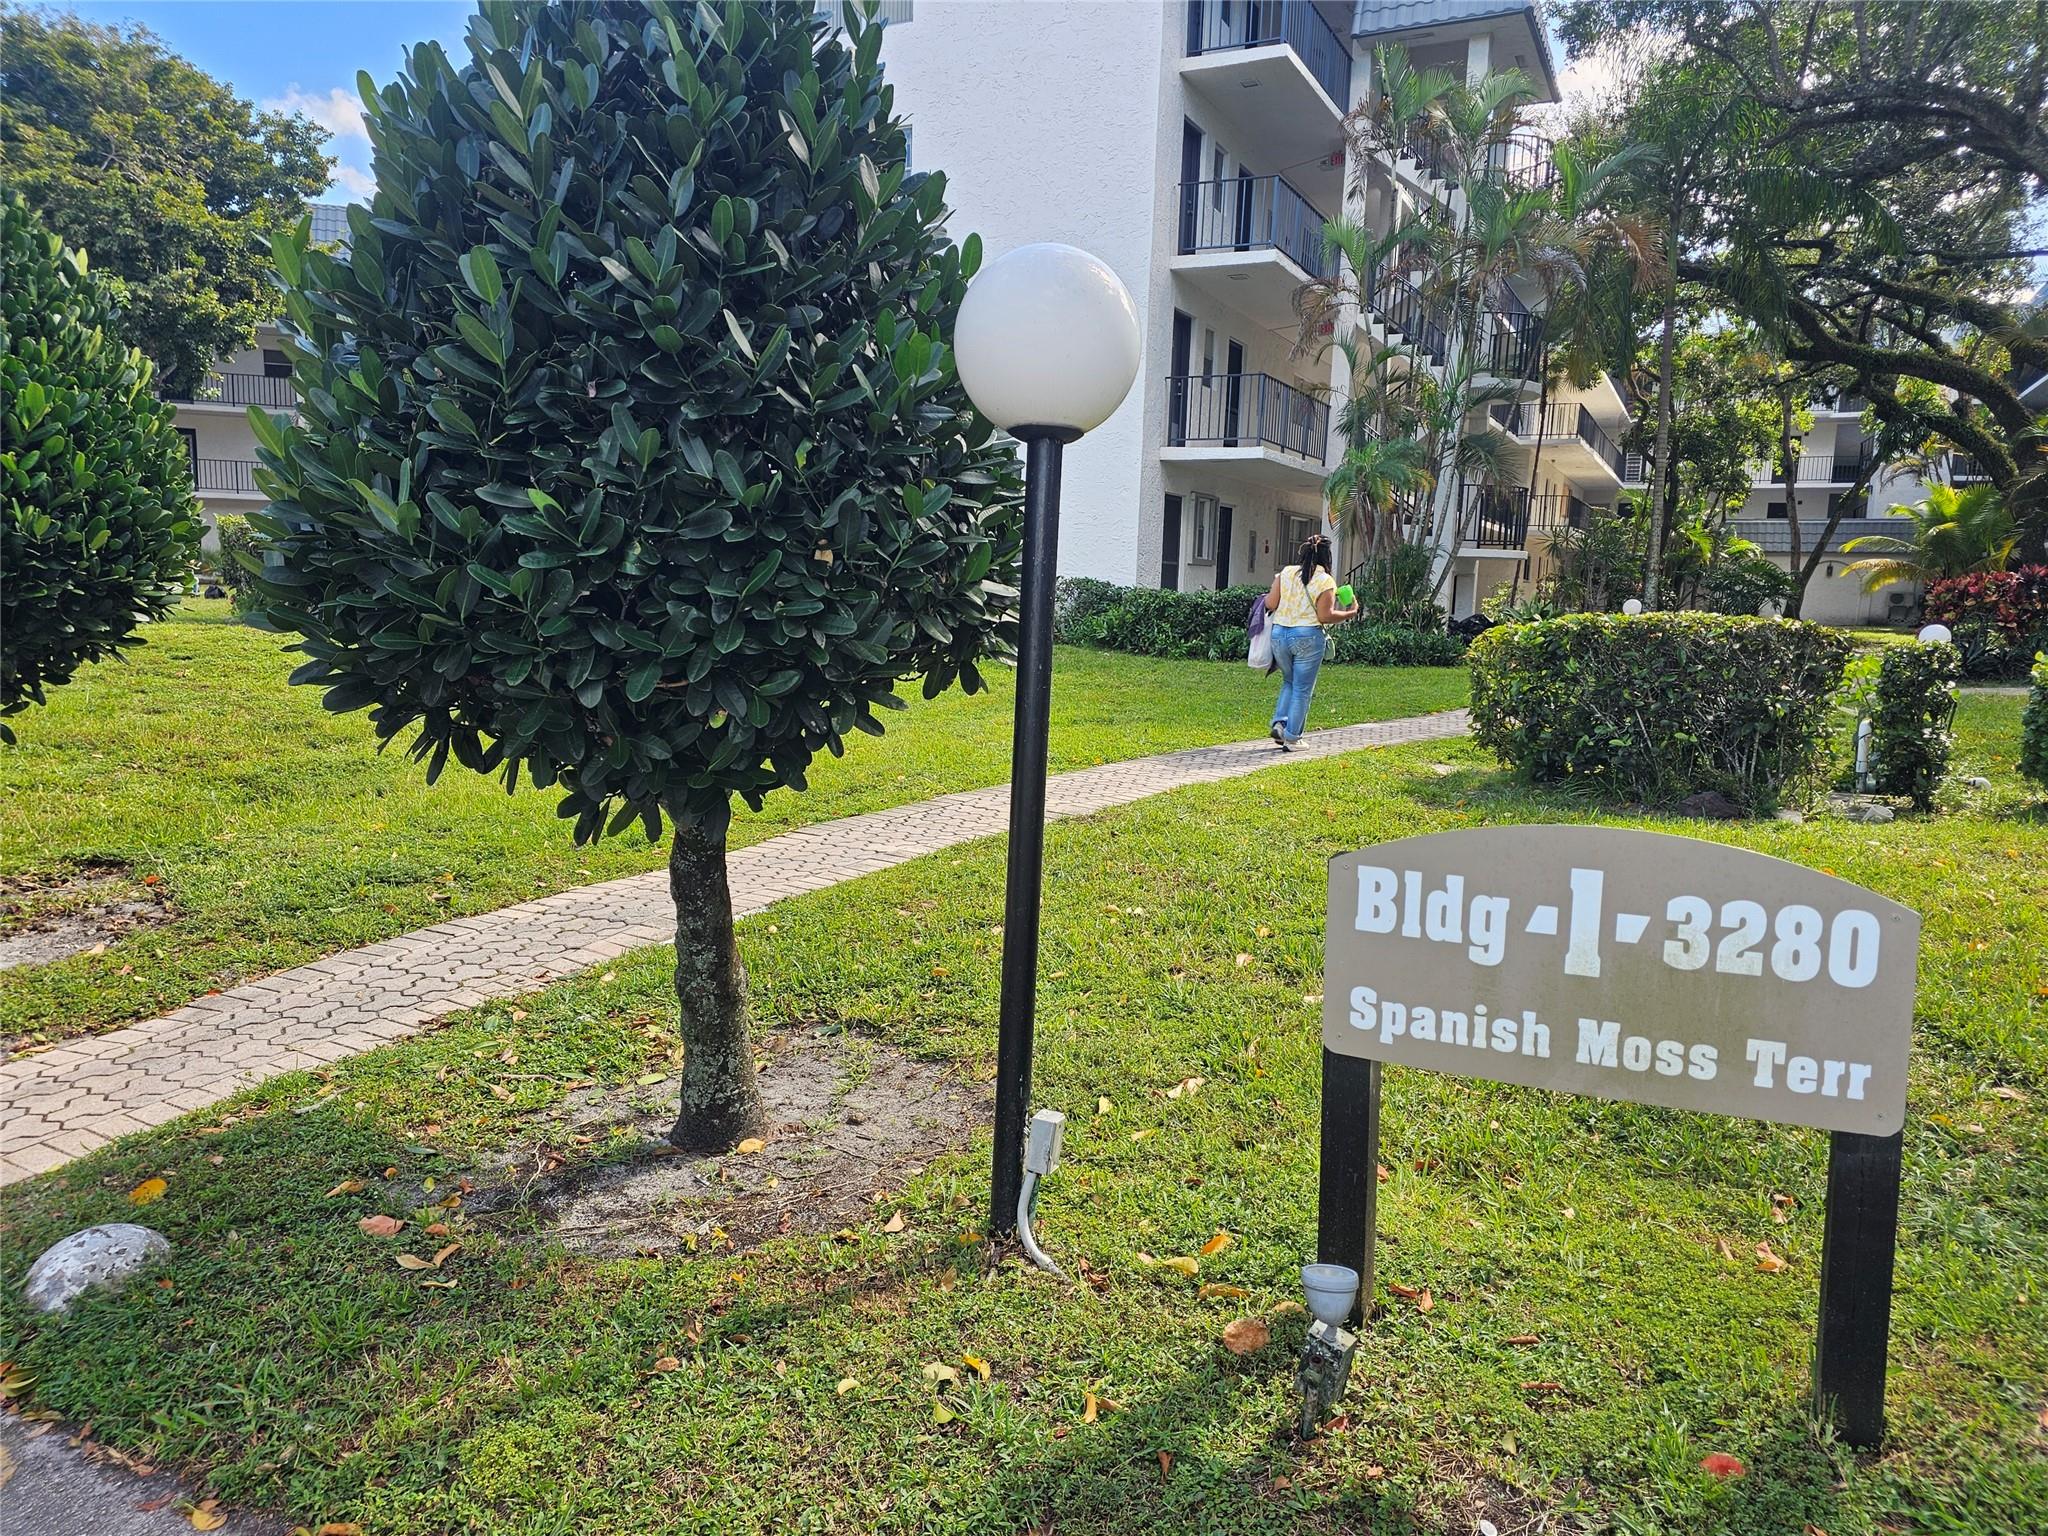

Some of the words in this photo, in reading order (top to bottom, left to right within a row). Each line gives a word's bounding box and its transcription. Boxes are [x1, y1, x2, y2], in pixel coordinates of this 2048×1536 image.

[1354, 864, 1511, 967] Bldg
[1662, 894, 1881, 989] 3280
[1349, 985, 1551, 1059] Spanish
[1575, 1017, 1718, 1081] Moss
[1745, 1038, 1873, 1101] Terr
